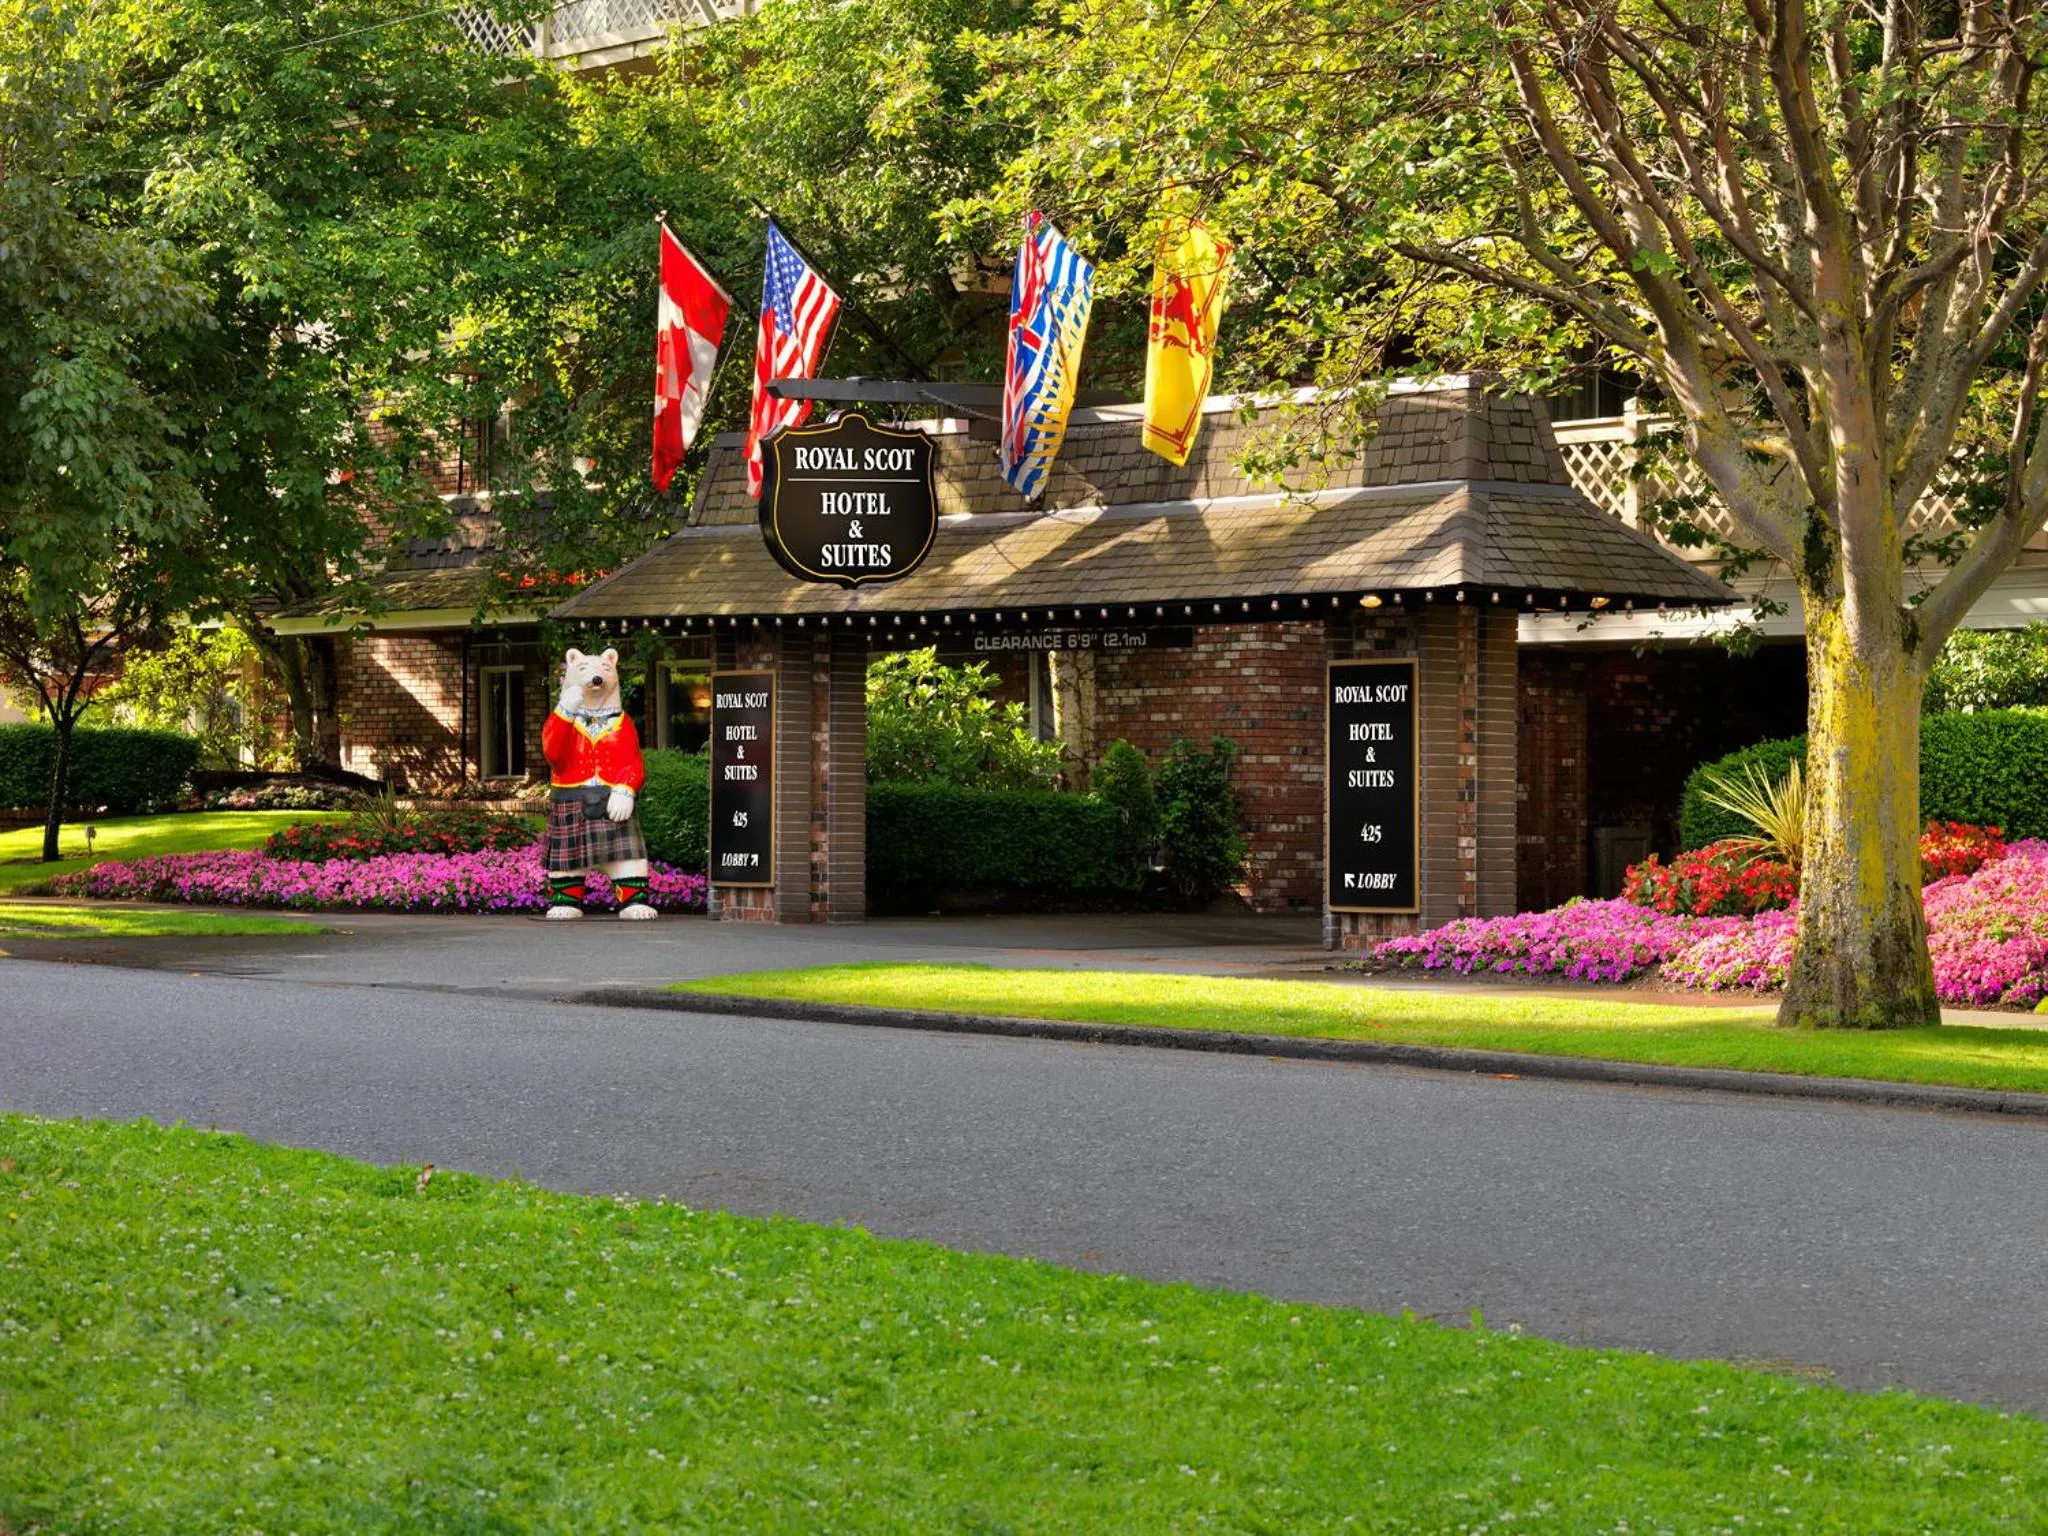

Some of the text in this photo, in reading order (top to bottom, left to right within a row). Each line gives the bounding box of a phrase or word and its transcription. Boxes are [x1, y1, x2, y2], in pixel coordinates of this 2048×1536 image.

[795, 447, 916, 471] ROYAL SCOT
[821, 492, 891, 515] HOTEL
[848, 519, 864, 538] &
[821, 544, 892, 567] SUITES
[974, 634, 1062, 650] CLEARANCE
[716, 692, 768, 709] ROYAL SCOT
[1335, 684, 1408, 704] ROYAL SCOT
[725, 725, 757, 741] HOTEL
[1349, 723, 1393, 741] HOTEL
[736, 745, 745, 760] &
[1365, 746, 1376, 763] &
[724, 765, 758, 781] SUITES
[1348, 769, 1395, 788] SUITES
[732, 811, 748, 828] 425
[1360, 823, 1382, 843] 425
[721, 853, 750, 867] LOBBY
[1357, 873, 1397, 889] LOBBY
